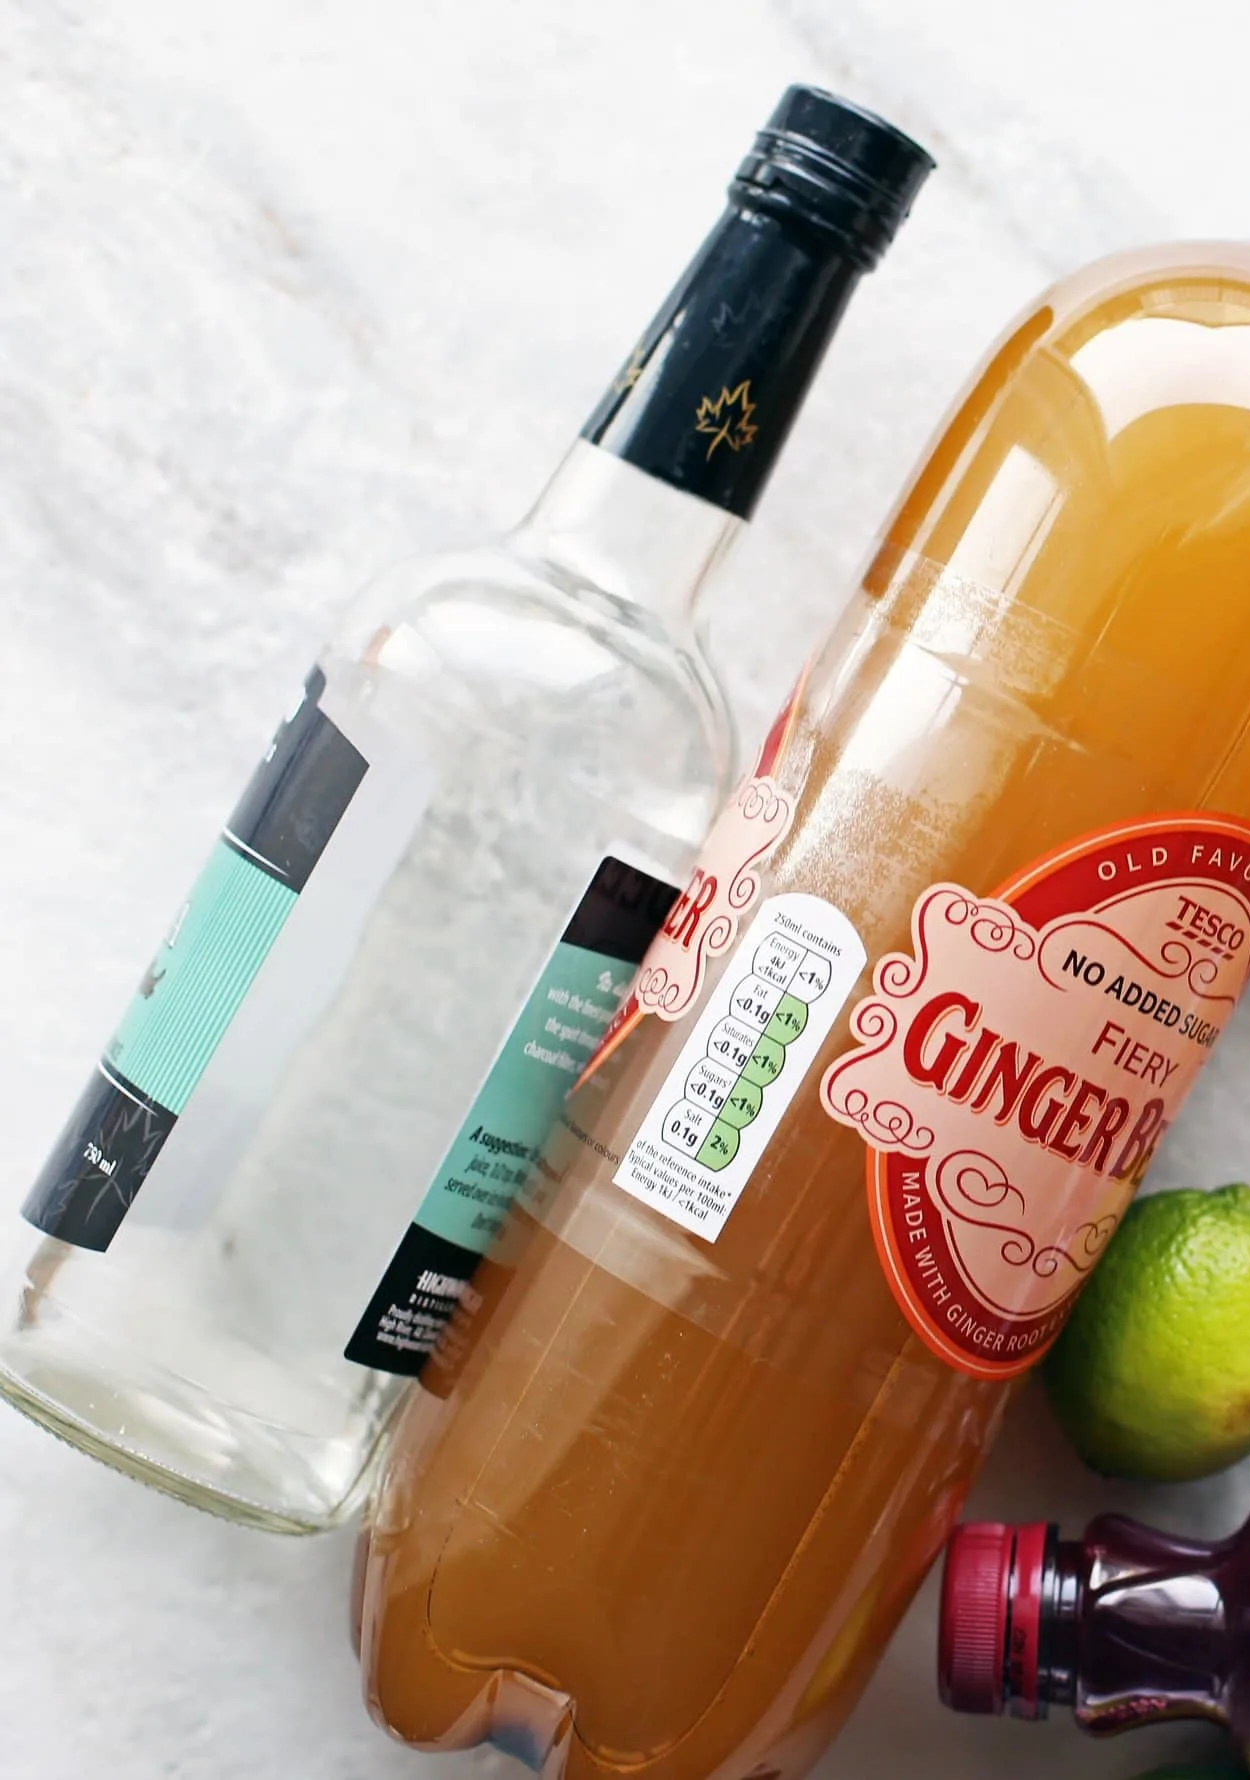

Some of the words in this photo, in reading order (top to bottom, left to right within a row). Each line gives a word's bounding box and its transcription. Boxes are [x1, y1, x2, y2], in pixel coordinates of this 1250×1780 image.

[1097, 846, 1169, 882] OLD
[774, 912, 803, 935] 250ml
[802, 931, 842, 957] contains
[1175, 894, 1245, 951] TESCO
[770, 937, 801, 963] Energy
[759, 966, 788, 985] <1kcal
[770, 956, 787, 970] 4kJ
[799, 972, 824, 991] <1%
[1063, 950, 1106, 987] NO
[1105, 976, 1181, 1028] ADDED
[736, 998, 771, 1025] <0.1g
[753, 984, 769, 1000] Fat
[776, 1013, 801, 1033] <1%
[713, 1041, 748, 1068] <0.1g
[723, 1023, 755, 1048] Saturates
[752, 1055, 778, 1075] <1%
[1092, 1022, 1179, 1087] FIERY
[690, 1083, 725, 1110] <0.1g
[904, 994, 1129, 1170] GINGER
[730, 1098, 756, 1118] <1%
[594, 1140, 620, 1165] colours
[671, 1121, 699, 1148] 0.1g
[686, 1109, 703, 1127] Salt
[710, 1135, 729, 1156] 2%
[629, 1149, 655, 1173] Typical
[653, 1168, 679, 1188] values
[678, 1184, 695, 1197] per
[697, 1192, 727, 1215] 100ml:
[636, 1140, 648, 1151] of
[645, 1145, 659, 1159] the
[659, 1154, 698, 1182] reference
[631, 1167, 658, 1192] Energy
[659, 1184, 674, 1200] 1kJ
[679, 1200, 709, 1221] <1kcal
[901, 1172, 927, 1243] MADE
[914, 1245, 950, 1306] WITH
[947, 1304, 1005, 1351] GINGER
[1007, 1321, 1046, 1359] ROOT
